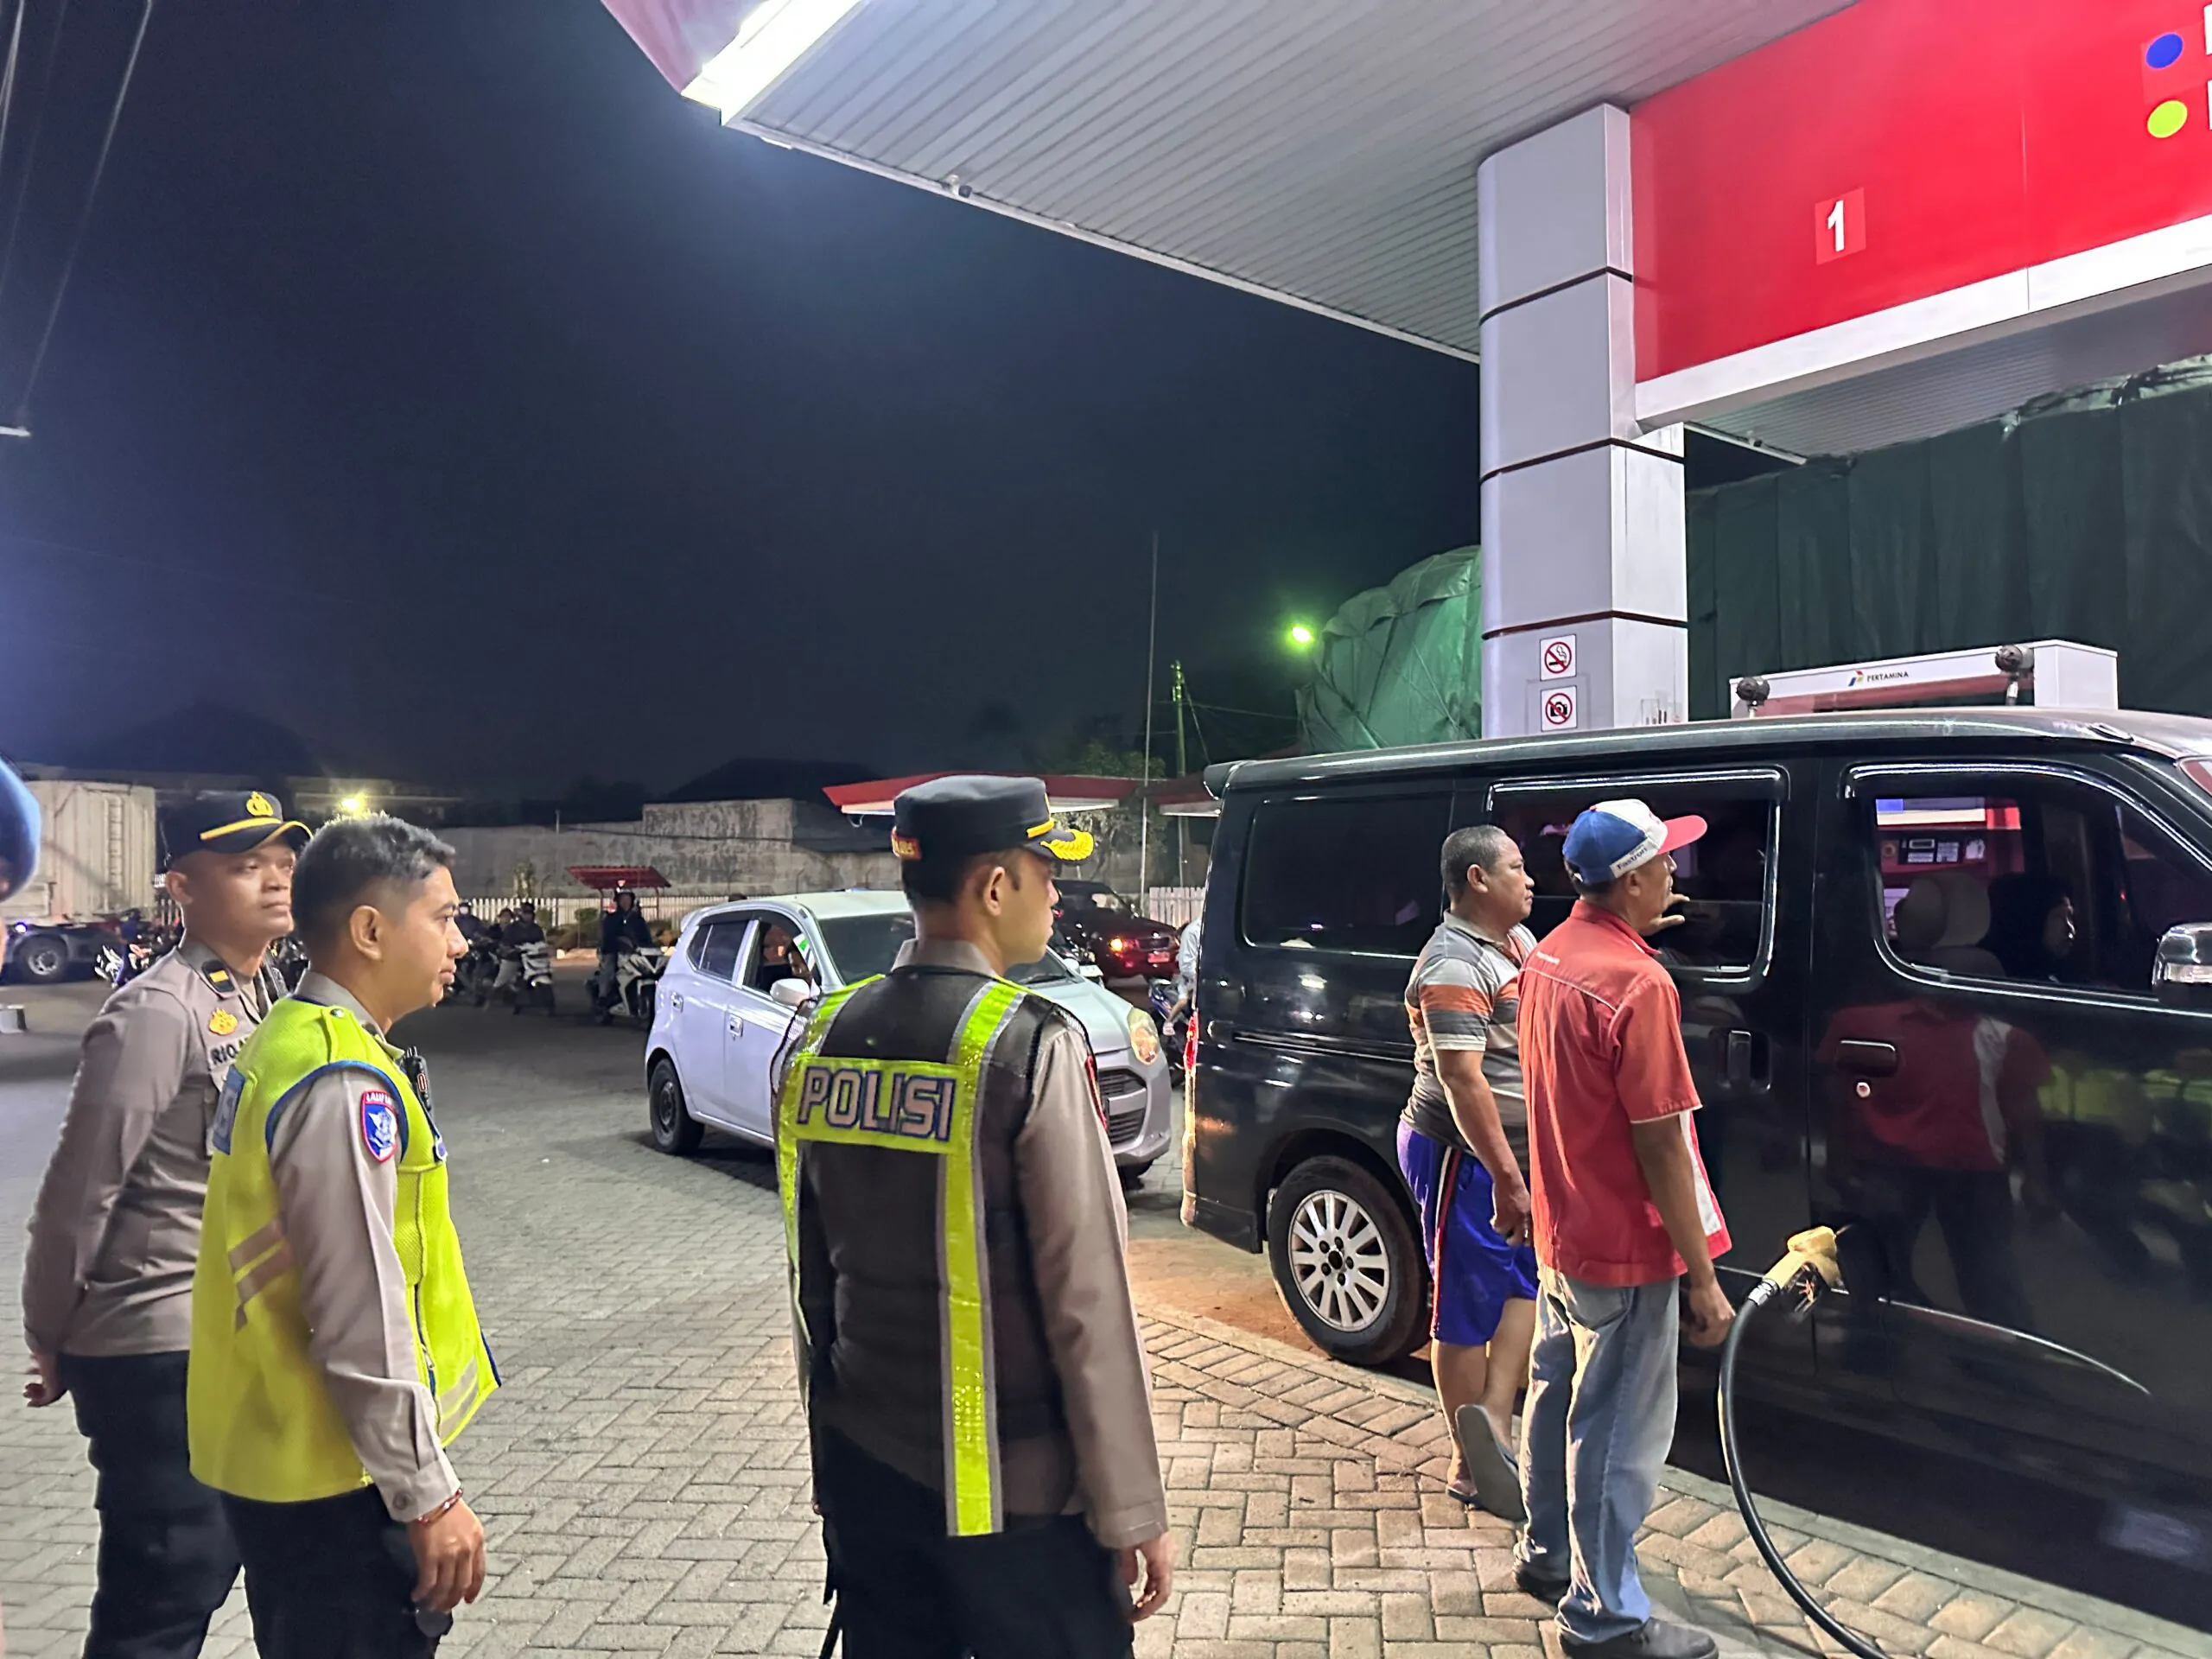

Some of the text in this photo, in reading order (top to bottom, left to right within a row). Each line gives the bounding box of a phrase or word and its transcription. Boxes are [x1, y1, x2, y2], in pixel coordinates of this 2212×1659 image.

[1827, 199, 1845, 252] 1
[1866, 671, 1909, 682] PERTAMINA
[1617, 847, 1648, 869] Fastron
[797, 1065, 957, 1141] POLISI
